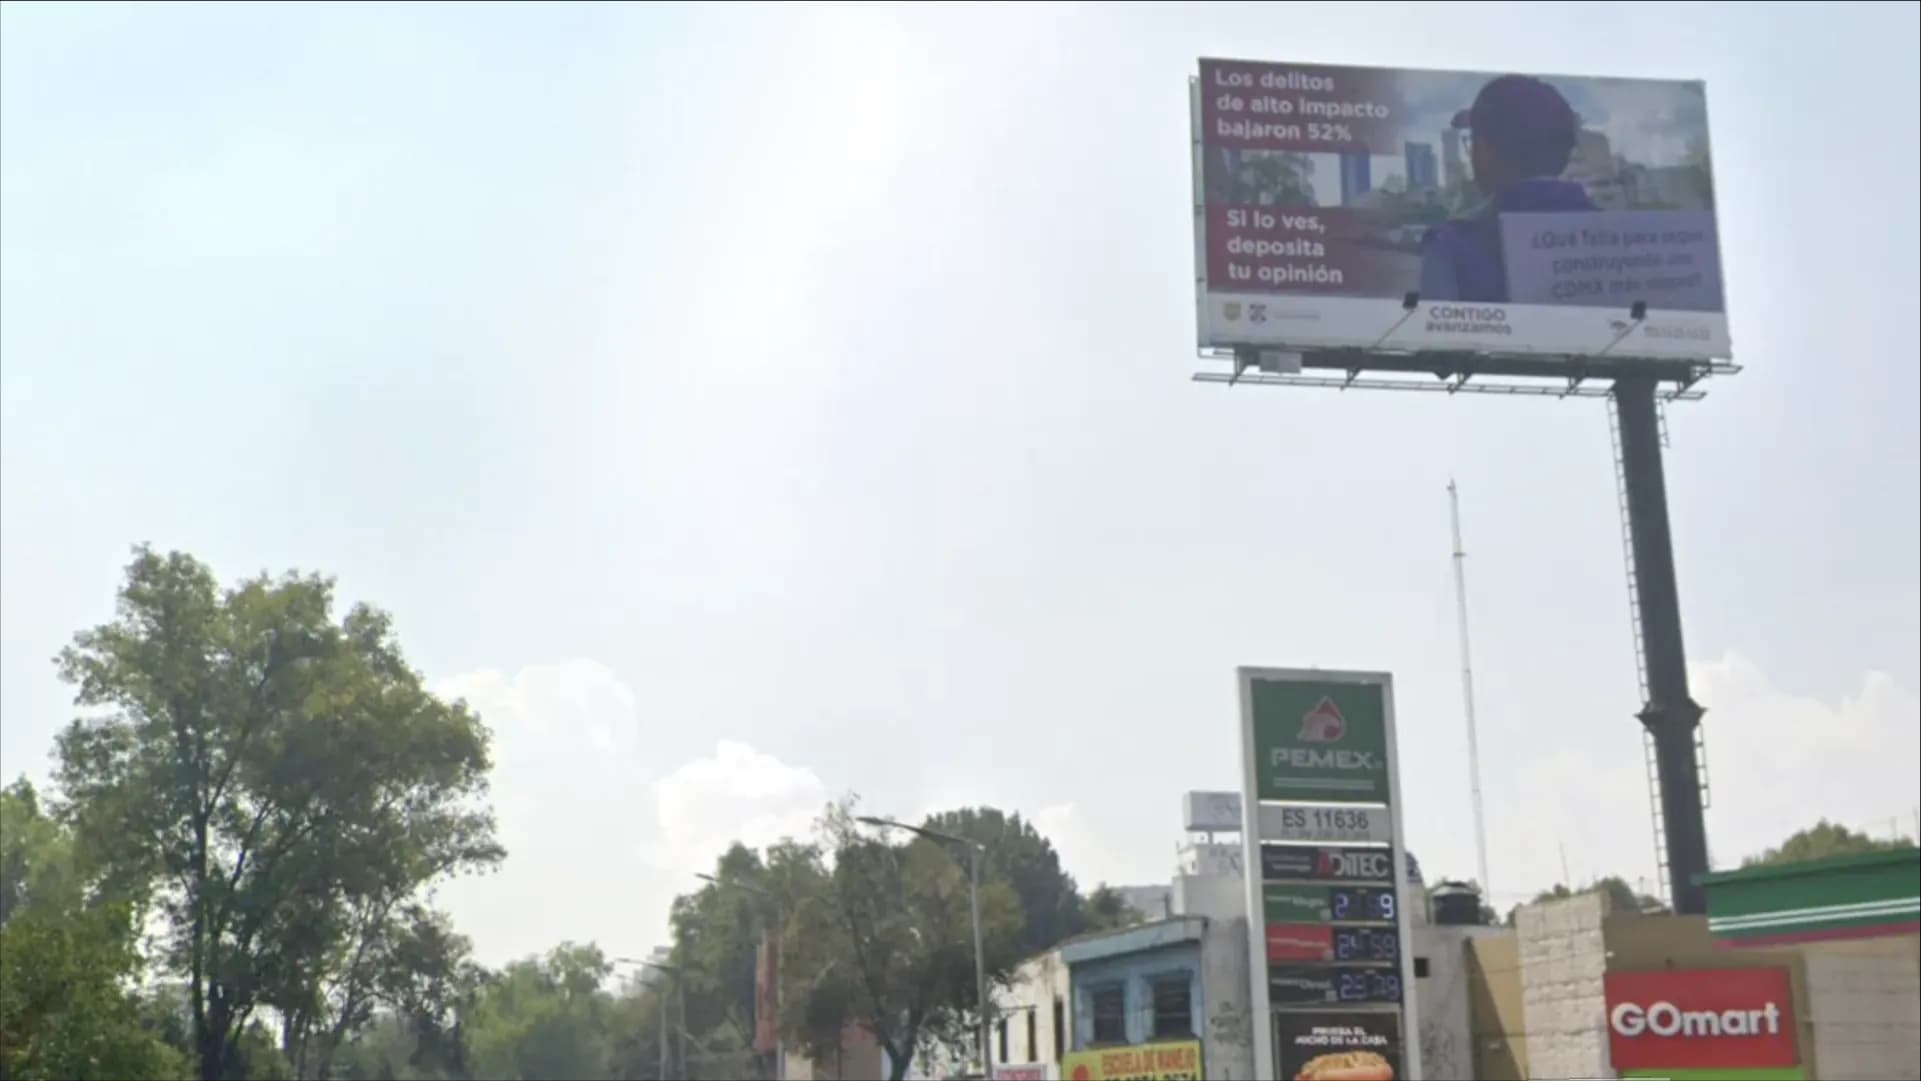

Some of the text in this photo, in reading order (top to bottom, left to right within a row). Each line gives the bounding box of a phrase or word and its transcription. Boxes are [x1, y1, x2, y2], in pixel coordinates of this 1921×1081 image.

[1215, 69, 1334, 91] Los delitos
[1216, 94, 1245, 111] de
[1251, 96, 1293, 114] alto
[1217, 118, 1352, 142] bajaron 52%
[1227, 210, 1325, 233] Si lo ves,
[1227, 237, 1325, 257] deposita
[1229, 262, 1343, 284] tu opinión
[1429, 306, 1506, 321] CONTIGO
[1426, 321, 1512, 335] avanzamos
[1271, 748, 1373, 768] PEMEX
[1282, 808, 1369, 830] ES 11636
[1611, 1002, 1779, 1035] GOmart
